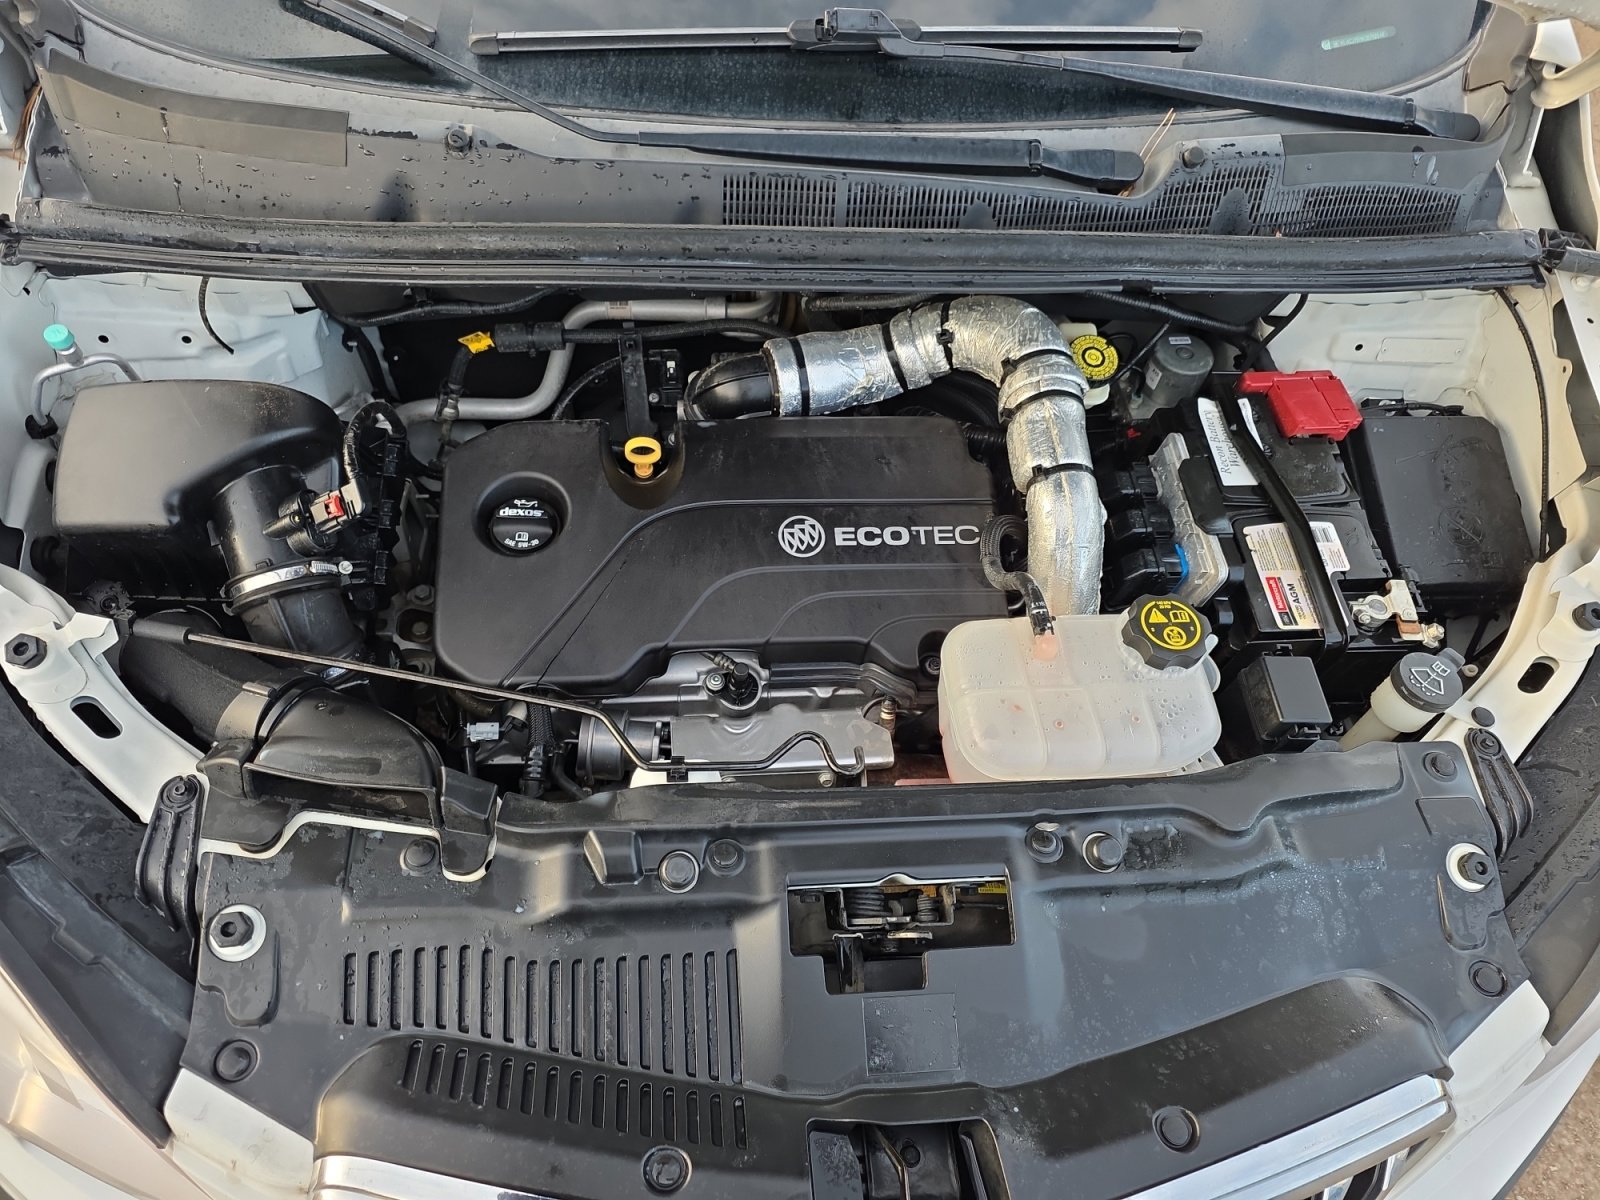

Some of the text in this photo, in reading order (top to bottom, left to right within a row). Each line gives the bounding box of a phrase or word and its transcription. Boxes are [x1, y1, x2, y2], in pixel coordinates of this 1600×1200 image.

[1204, 410, 1231, 474] Recon Battery
[499, 507, 544, 517] dexos
[504, 538, 540, 548] SAE 5W-30
[834, 525, 980, 546] ECOTEC
[1268, 578, 1284, 608] Motorcraft
[1287, 583, 1302, 605] AGM
